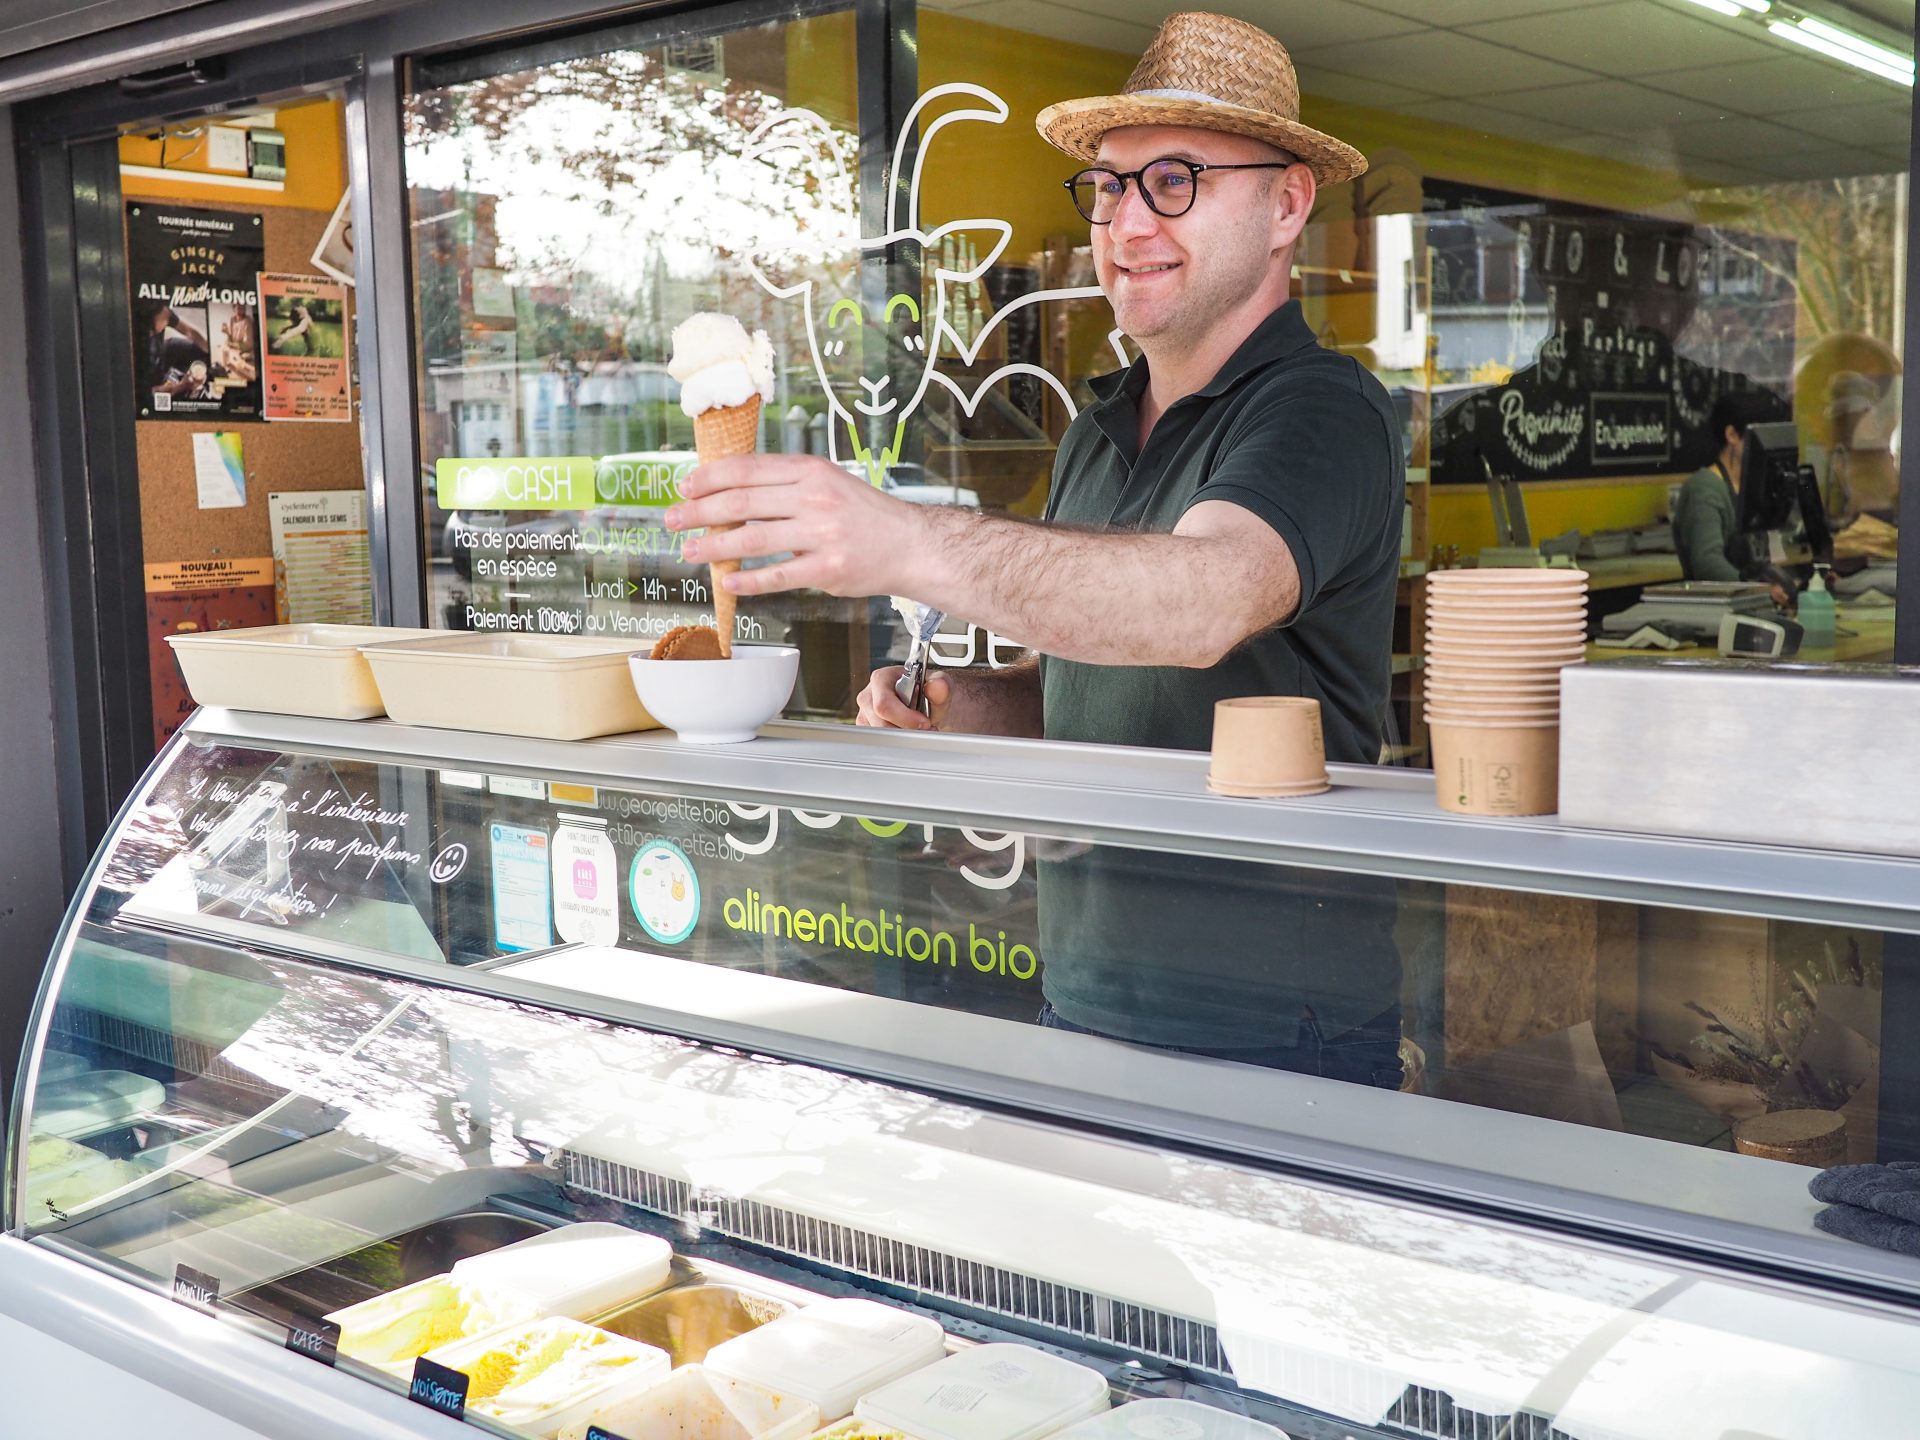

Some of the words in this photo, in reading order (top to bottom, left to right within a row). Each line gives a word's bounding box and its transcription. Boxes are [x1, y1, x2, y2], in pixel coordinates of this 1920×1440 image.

[170, 246, 225, 265] GINGER
[181, 262, 216, 275] JACK
[138, 283, 171, 300] ALL
[211, 288, 257, 306] LONG
[503, 465, 572, 502] CASH
[282, 515, 315, 525] CALENDRIER
[317, 514, 328, 524] DES
[330, 514, 347, 523] SEMIS
[454, 527, 479, 548] Pas
[481, 527, 503, 549] de
[505, 528, 578, 555] paiement
[582, 527, 661, 556] OUVERT
[181, 561, 227, 573] NOUVEAU
[477, 559, 497, 576] en
[499, 554, 557, 582] espèce
[583, 576, 624, 599] Lundi
[642, 577, 667, 601] 14h
[681, 578, 707, 603] 19h
[466, 605, 534, 631] Paiement
[537, 608, 574, 633] 100%
[586, 616, 606, 631] au
[610, 609, 680, 634] Vendredi
[736, 615, 763, 640] 19h
[210, 782, 240, 803] Vous
[303, 789, 409, 827] l'intérieur
[302, 836, 336, 853] vos
[335, 836, 421, 880] parfums
[723, 887, 956, 967] alimentation
[969, 923, 1037, 980] bio
[292, 1325, 331, 1351] CAFÉ
